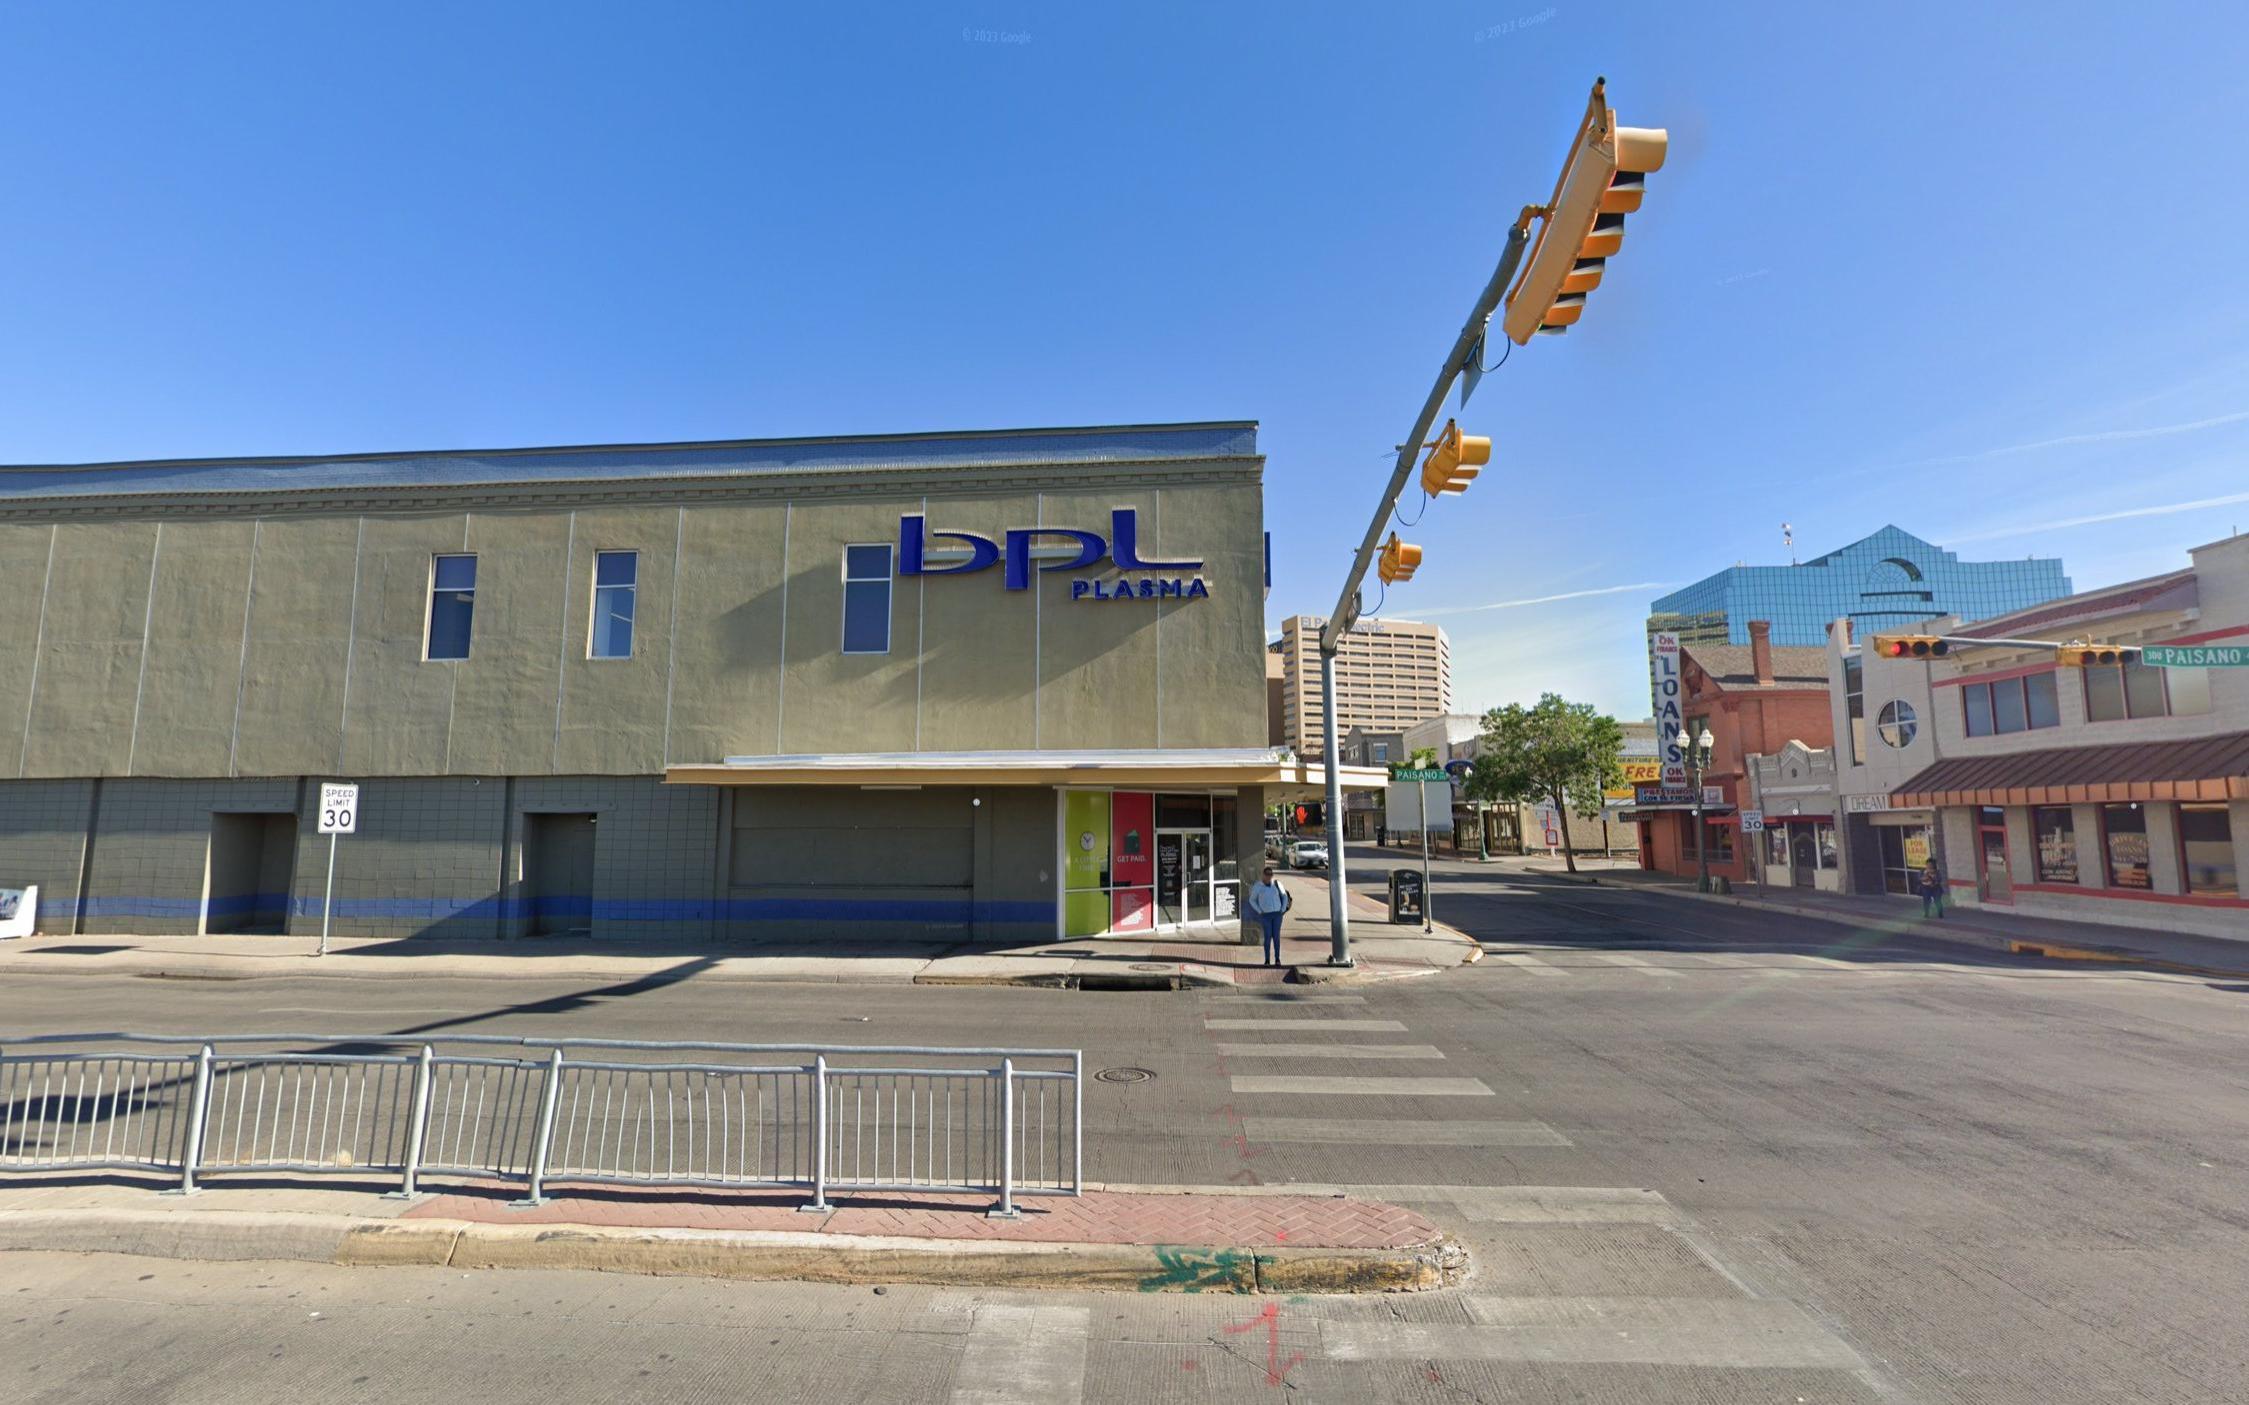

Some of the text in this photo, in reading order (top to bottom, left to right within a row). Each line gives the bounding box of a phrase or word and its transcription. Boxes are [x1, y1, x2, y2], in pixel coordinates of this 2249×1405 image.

[1072, 577, 1209, 600] PLASMA
[1659, 635, 1674, 645] OK
[2165, 648, 2241, 664] PAISANO
[1662, 656, 1682, 764] LOANS
[1396, 770, 1438, 780] PAISANO
[1625, 766, 1660, 779] FRE
[1667, 767, 1683, 776] OK
[325, 789, 355, 798] SPEED
[327, 799, 351, 807] LIMIT
[1851, 796, 1887, 811] DREAM
[324, 809, 352, 828] 30
[1744, 820, 1762, 830] 30
